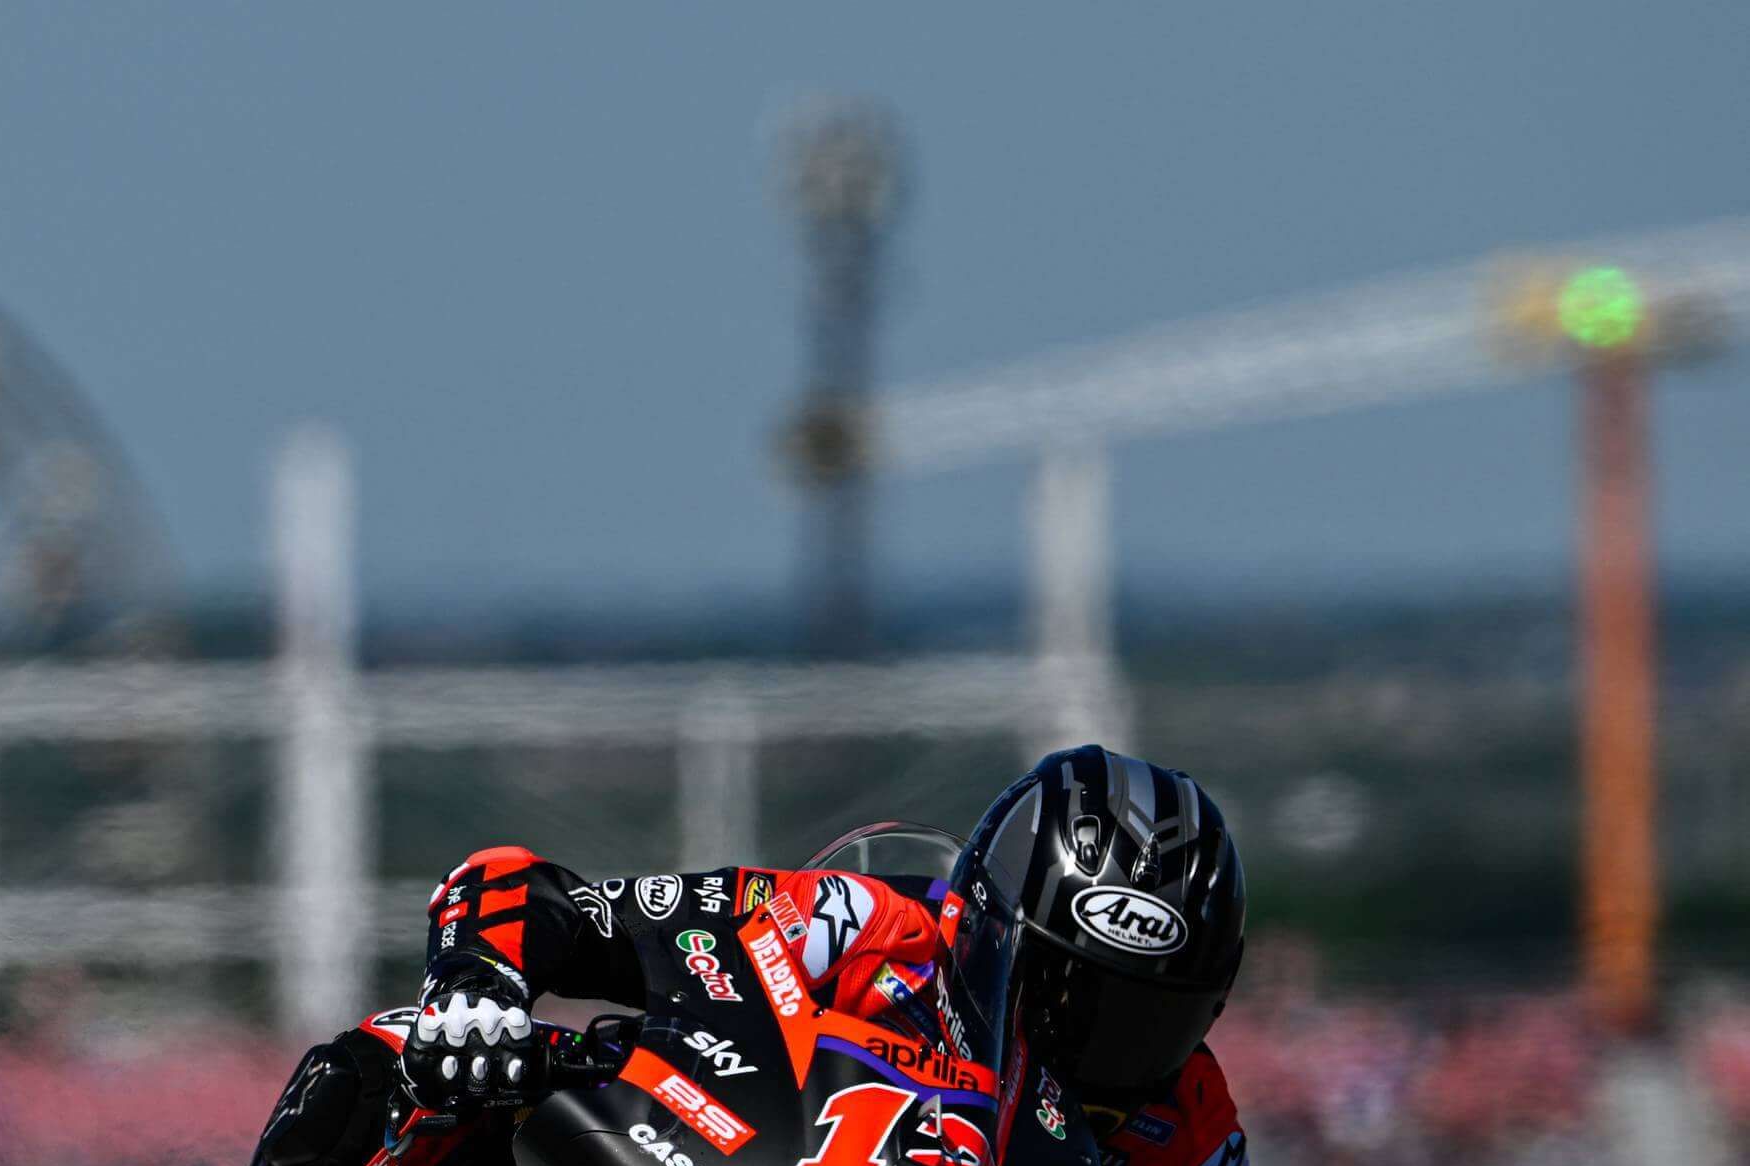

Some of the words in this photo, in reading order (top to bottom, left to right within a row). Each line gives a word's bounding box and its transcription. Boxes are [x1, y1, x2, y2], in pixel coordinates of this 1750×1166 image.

[1082, 896, 1176, 941] Arai
[683, 1031, 759, 1077] sky
[865, 1036, 979, 1092] aprilia
[659, 1074, 749, 1140] BS
